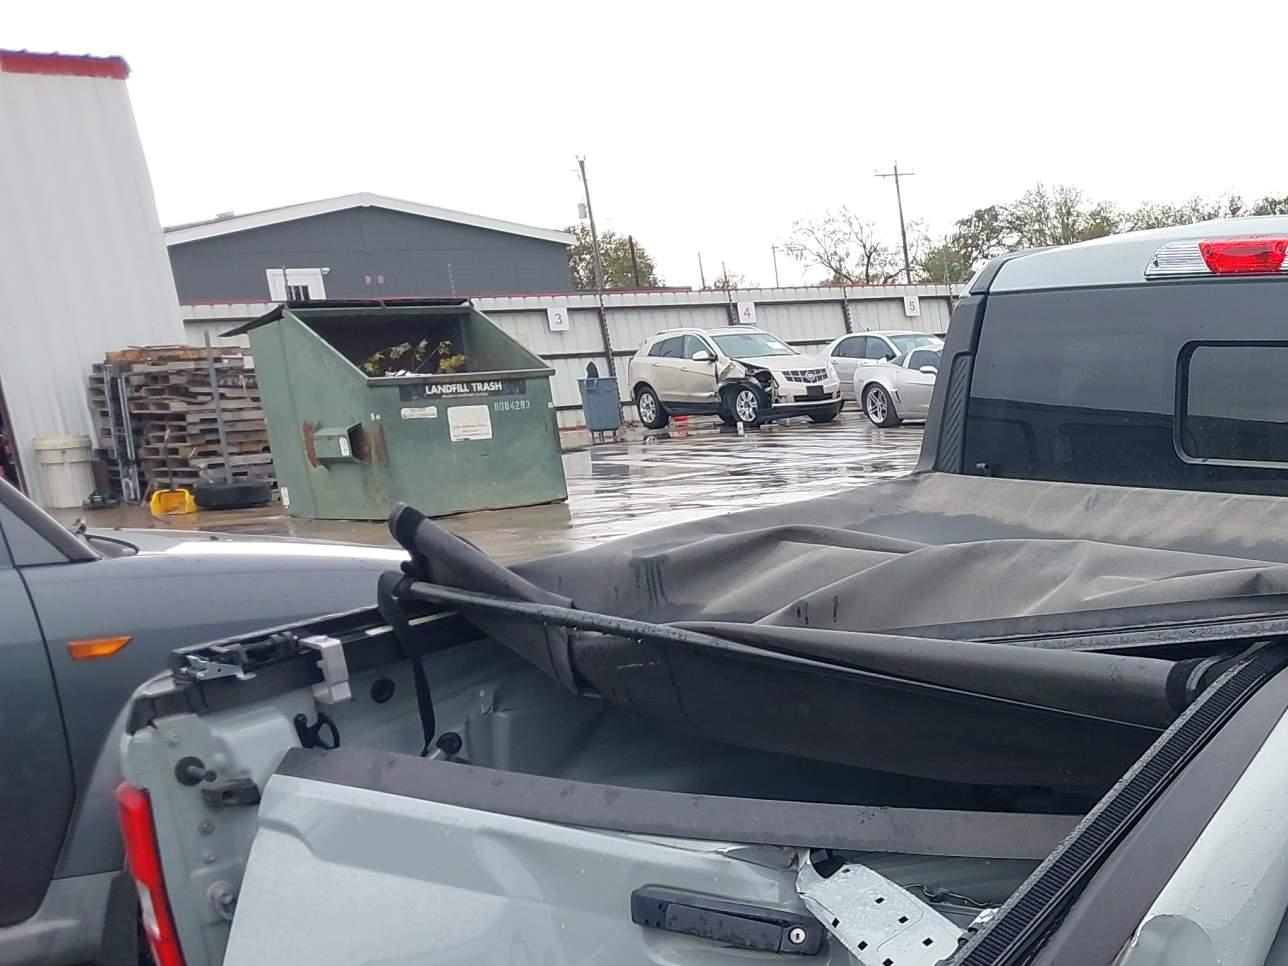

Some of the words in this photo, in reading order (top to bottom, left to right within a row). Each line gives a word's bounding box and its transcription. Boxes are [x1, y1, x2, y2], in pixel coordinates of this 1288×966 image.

[909, 301, 916, 311] 5
[554, 313, 563, 325] 3
[743, 307, 751, 319] 4
[425, 383, 470, 395] LANDFILL
[470, 381, 503, 393] TRASH
